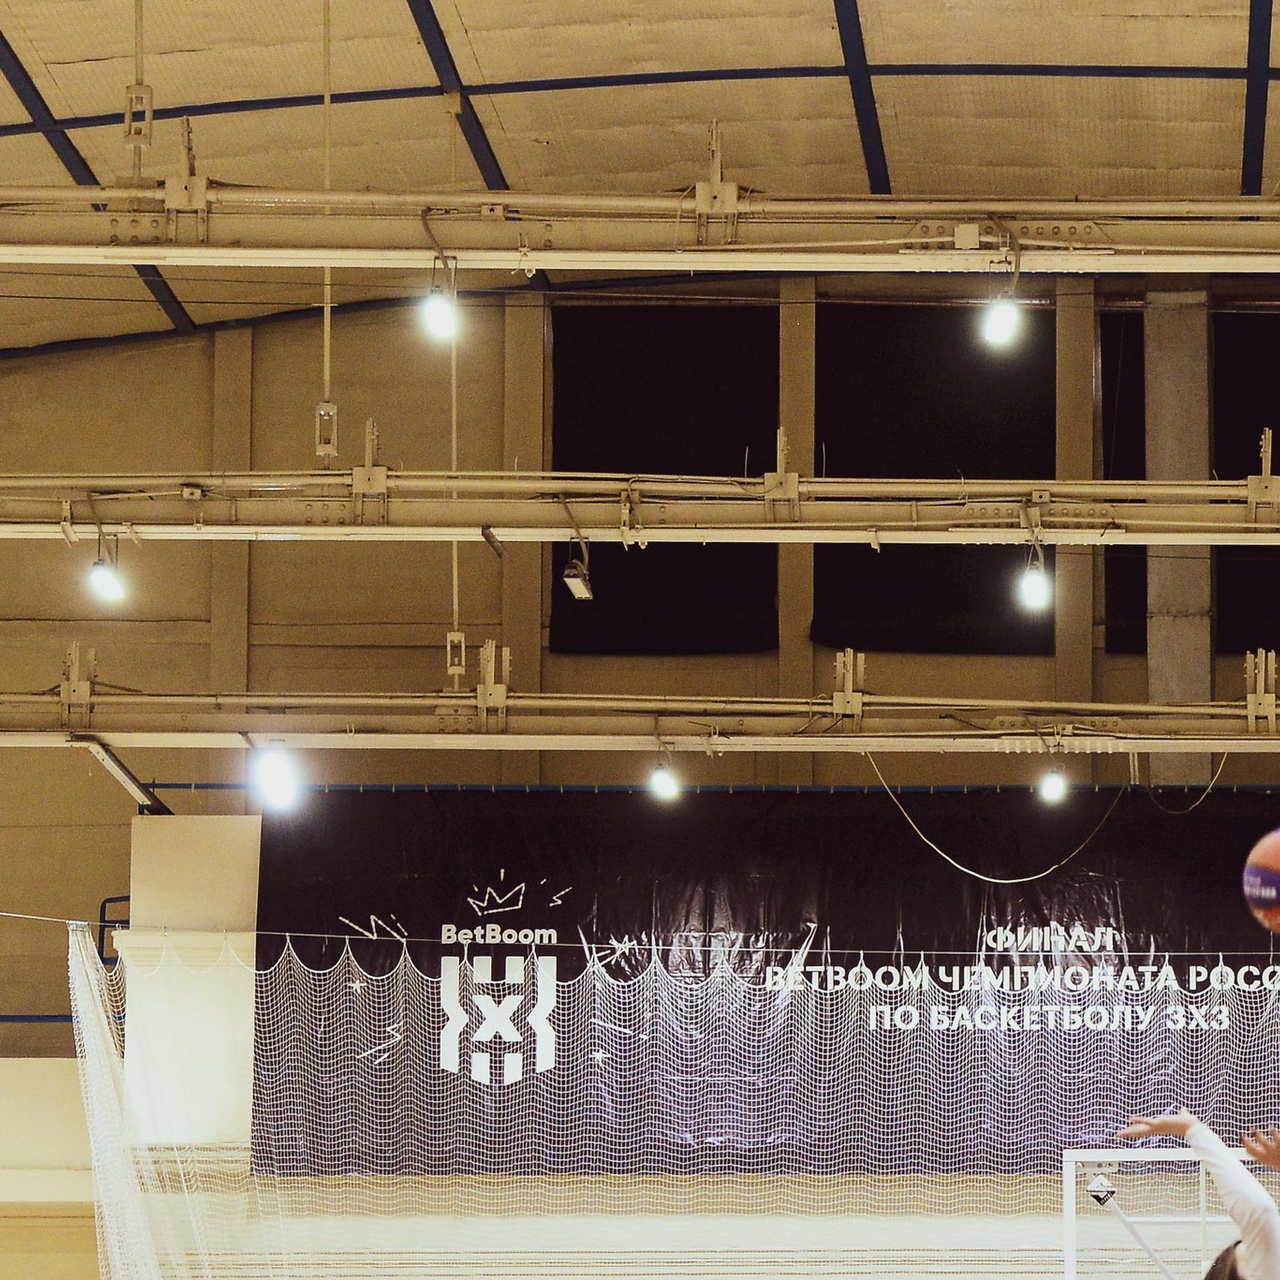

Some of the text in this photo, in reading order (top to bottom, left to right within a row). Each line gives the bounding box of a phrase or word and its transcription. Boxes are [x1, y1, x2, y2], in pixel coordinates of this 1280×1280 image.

[441, 924, 557, 944] BetBoom
[986, 926, 1114, 952] ФИНАЛ
[938, 965, 1179, 991] ЧЕМПИОНАТА
[869, 1005, 920, 1030] ПО
[930, 1005, 1155, 1031] БАСКЕТБОЛУ
